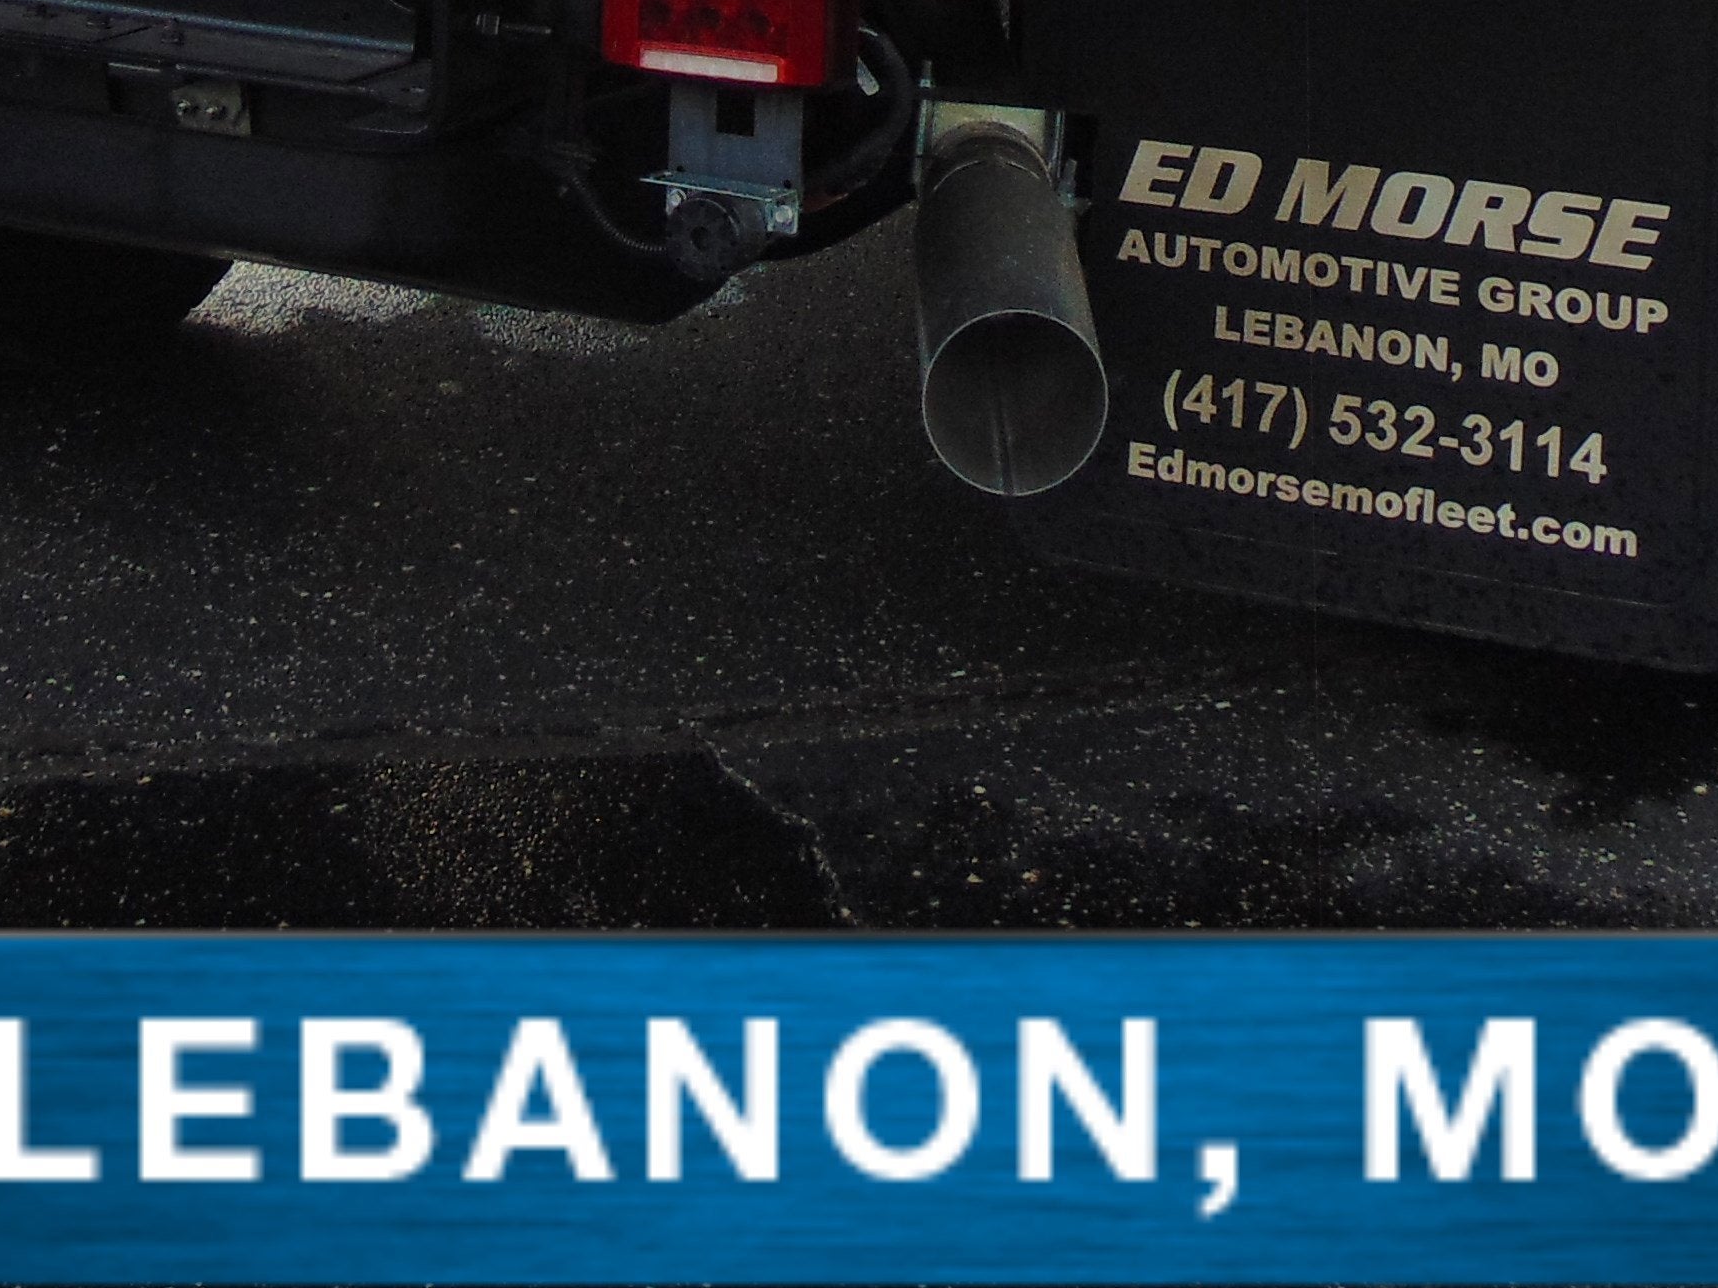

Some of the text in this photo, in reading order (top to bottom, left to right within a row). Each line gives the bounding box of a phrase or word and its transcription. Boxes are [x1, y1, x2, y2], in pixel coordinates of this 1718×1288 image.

[1117, 138, 1672, 272] ED MORSE
[1116, 228, 1670, 335] AUTOMOTIVE GROUP
[1213, 304, 1560, 389] LEBANON, MO
[1162, 368, 1609, 485] (417) 532-3114
[1126, 440, 1638, 559] Edmorsemofleet.com
